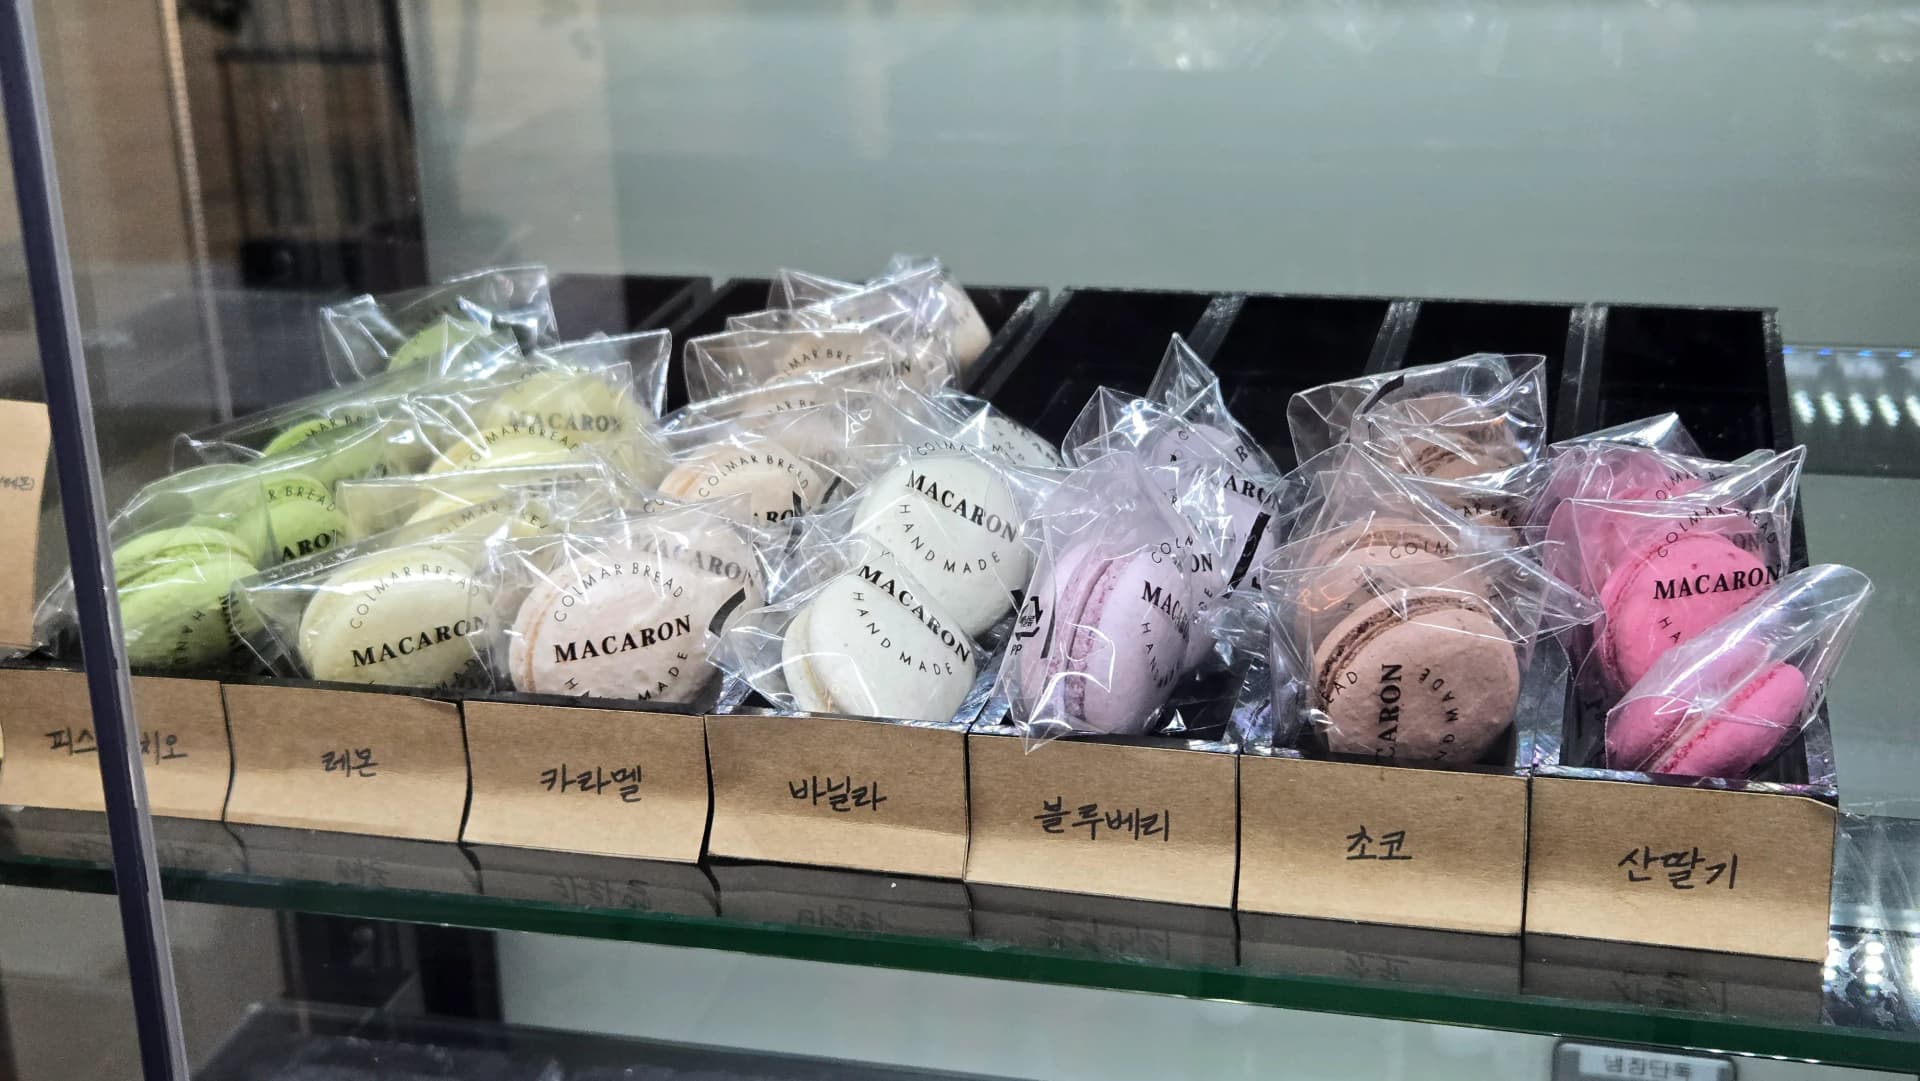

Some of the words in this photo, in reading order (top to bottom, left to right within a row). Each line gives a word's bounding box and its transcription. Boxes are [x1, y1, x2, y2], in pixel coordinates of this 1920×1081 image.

[284, 486, 337, 512] BREAD
[905, 470, 1017, 543] MACARON
[899, 504, 935, 562] HAND
[943, 551, 1000, 574] MADE
[553, 563, 623, 622] COLMAR
[632, 562, 684, 598] BREAD
[1652, 564, 1782, 601] MACARON
[852, 592, 892, 650] HAND
[899, 651, 953, 676] MADE
[857, 565, 971, 663] MACARON
[554, 615, 692, 664] MACARON
[45, 727, 189, 765] 피스치오
[321, 748, 379, 778] 레몬
[540, 764, 643, 803] 카라멜
[788, 775, 888, 813] 바닐라
[1033, 796, 1170, 842] 블루베리
[1346, 824, 1413, 861] 초코
[1617, 845, 1739, 891] 산딸기
